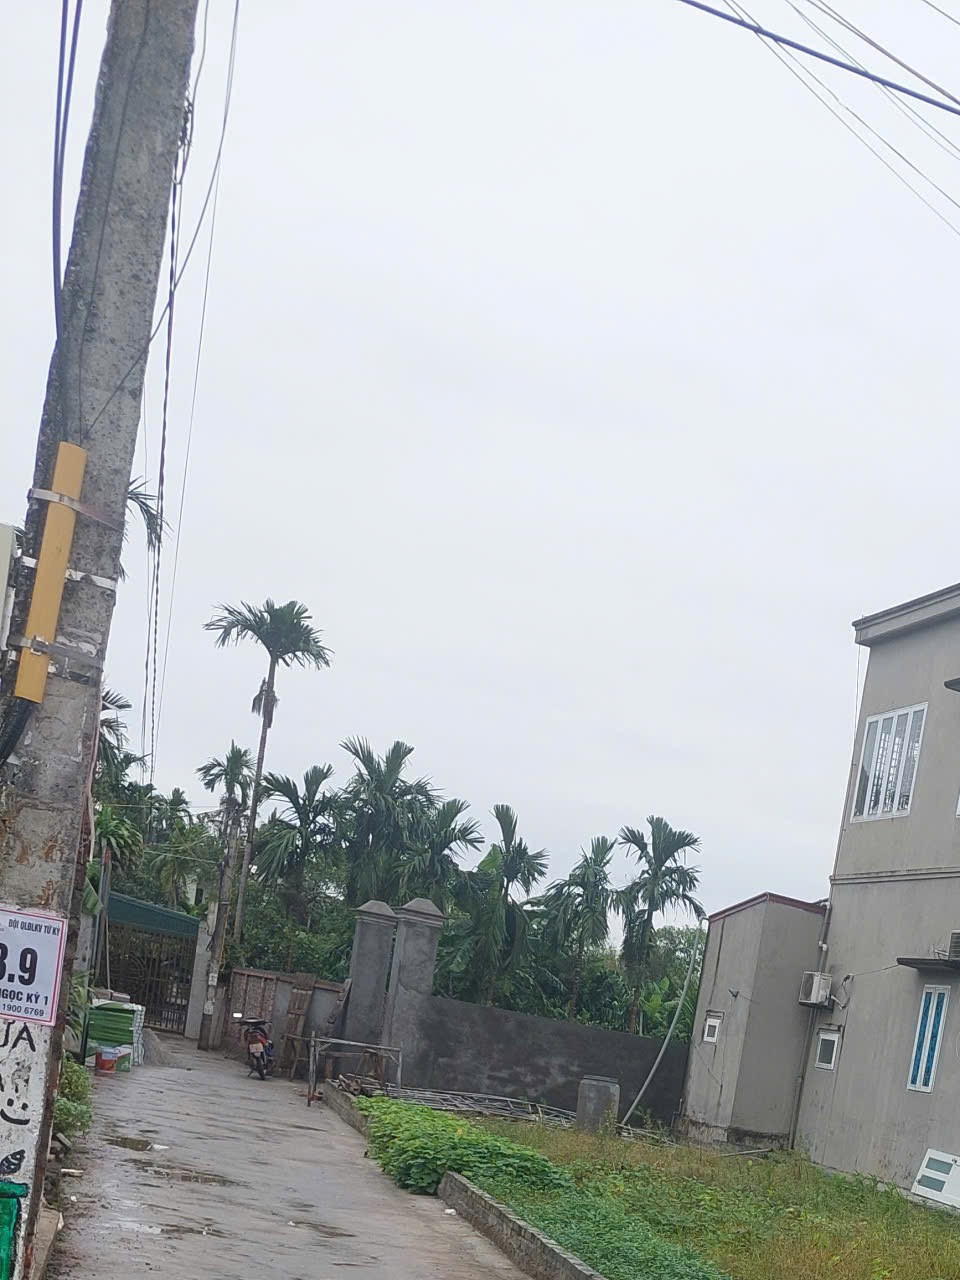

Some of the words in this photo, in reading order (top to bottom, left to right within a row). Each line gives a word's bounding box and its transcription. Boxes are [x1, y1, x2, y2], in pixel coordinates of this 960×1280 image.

[0, 988, 23, 1003] GỌC
[44, 995, 49, 1006] 1
[2, 1003, 22, 1013] 1900
[24, 1006, 45, 1017] 6769
